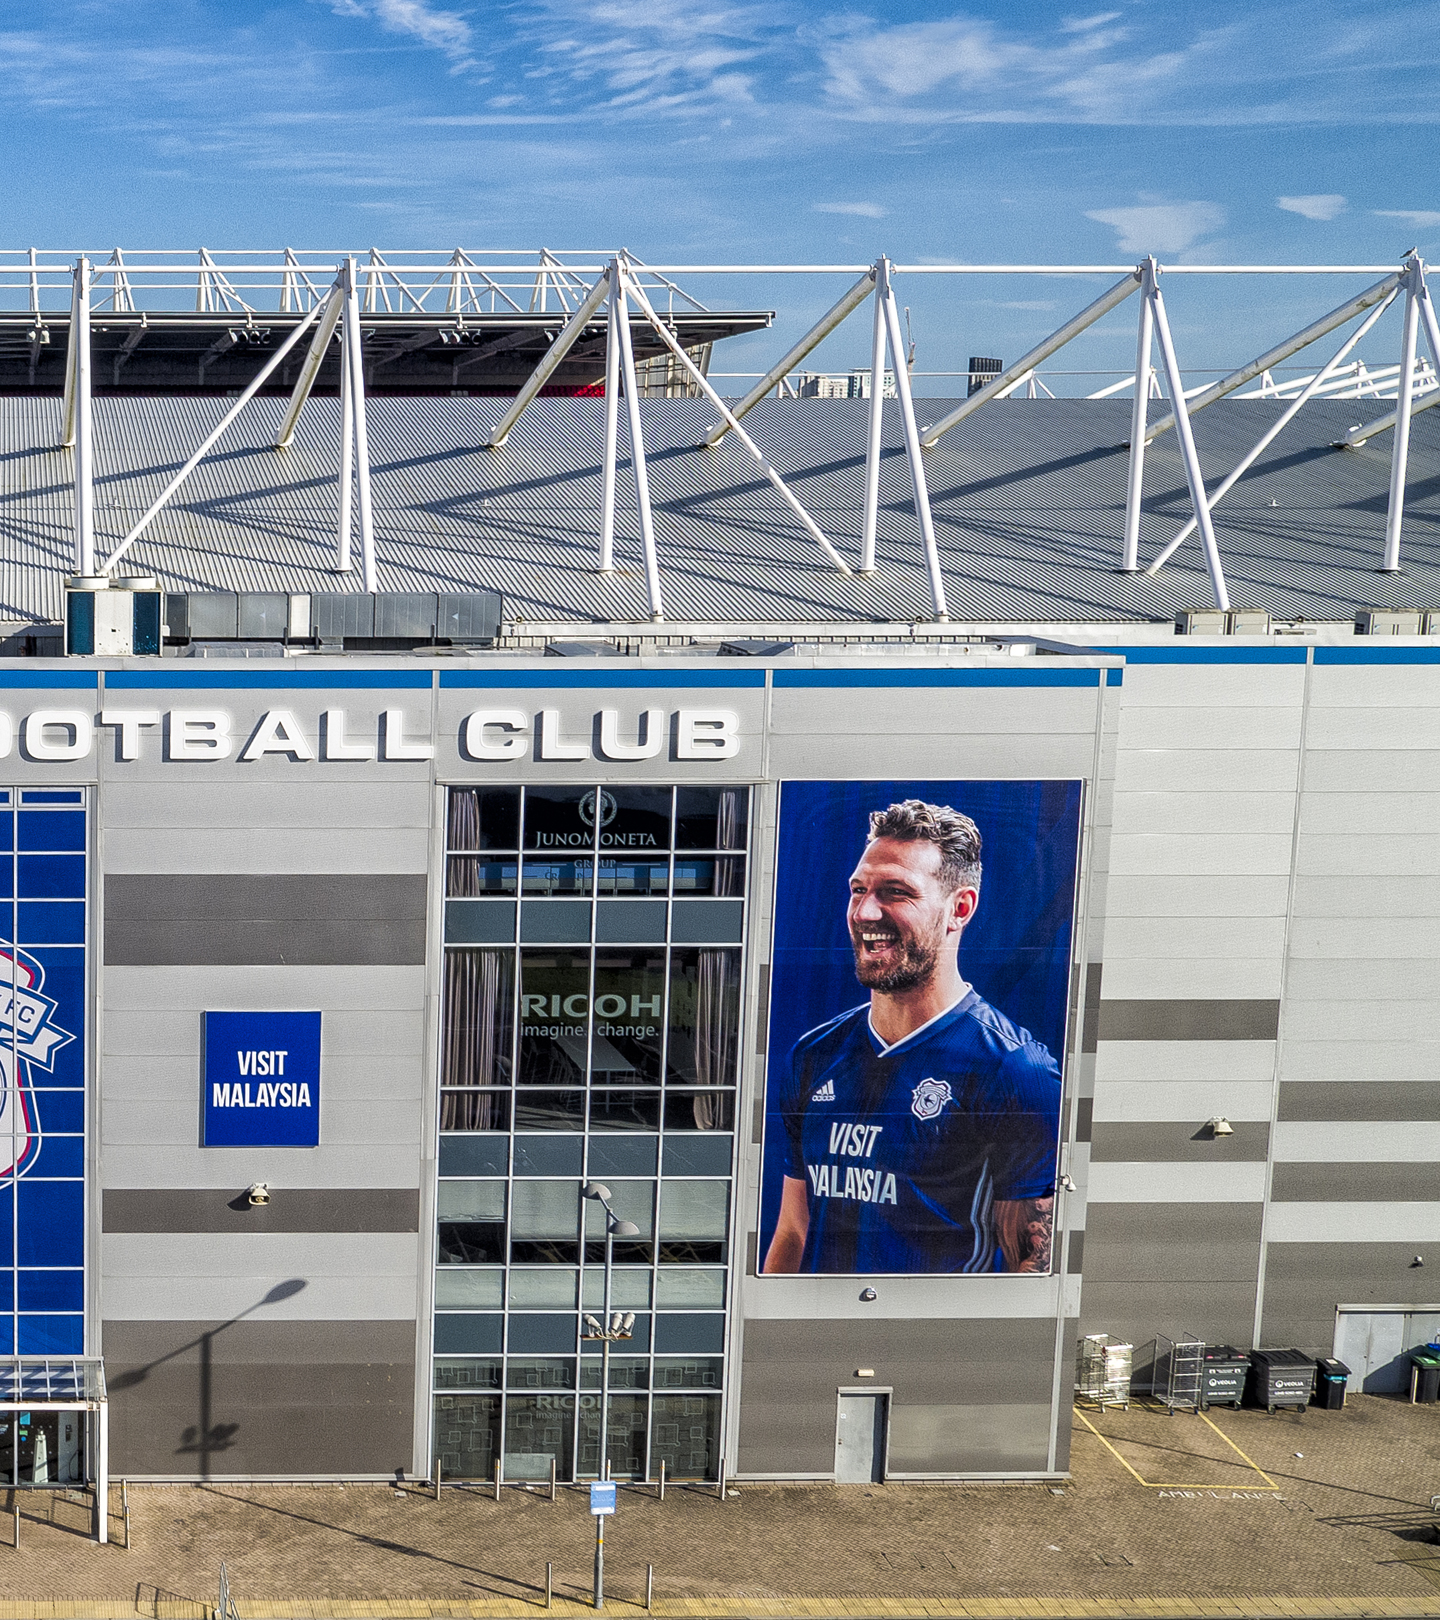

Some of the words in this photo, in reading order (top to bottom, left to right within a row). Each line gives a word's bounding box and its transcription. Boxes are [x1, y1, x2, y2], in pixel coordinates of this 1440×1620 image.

[465, 709, 740, 760] CLUB
[4, 998, 36, 1025] FC
[521, 994, 661, 1018] RICOH
[521, 1022, 588, 1040] imagine.
[597, 1022, 660, 1040] change.
[237, 1050, 288, 1075] VISIT
[213, 1082, 311, 1107] MALAYSIA
[829, 1121, 883, 1158] VISIT
